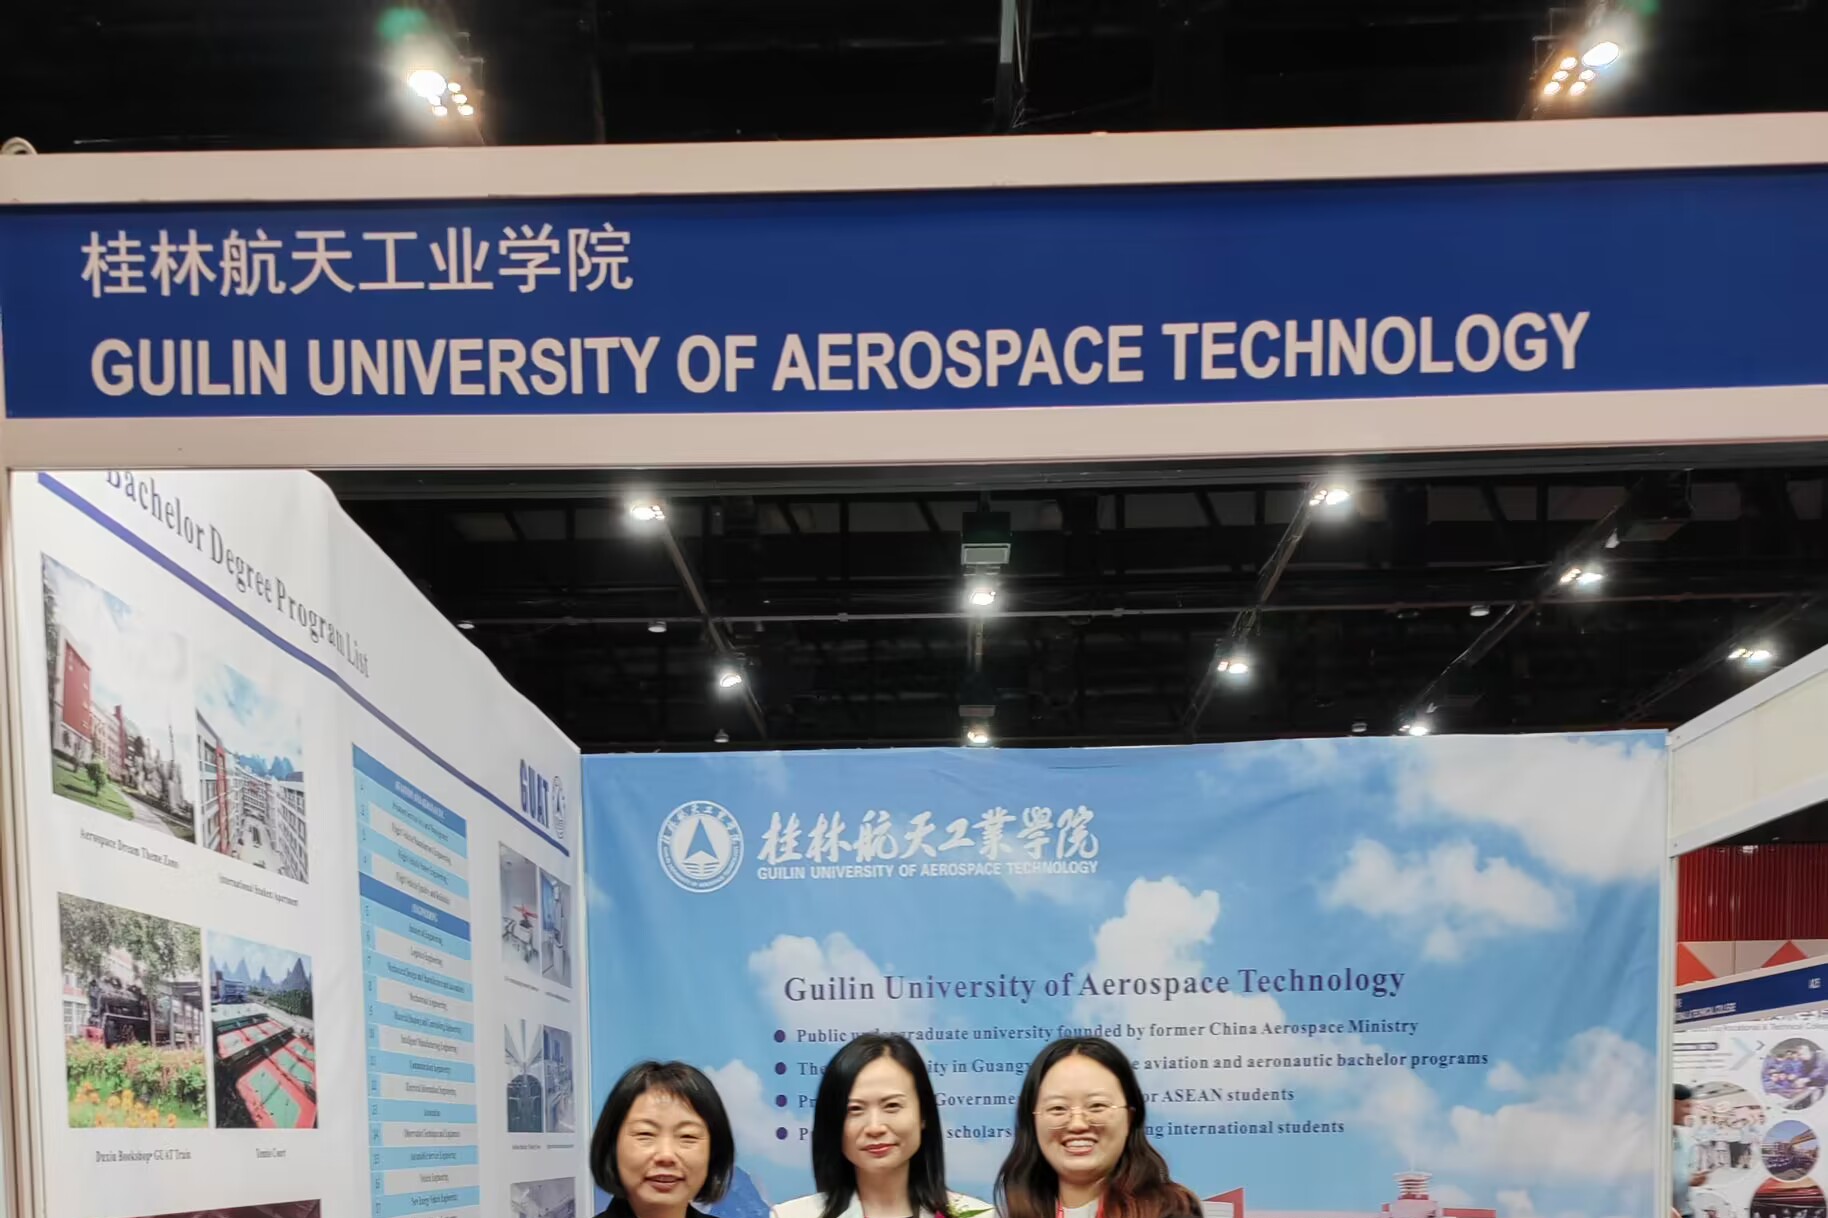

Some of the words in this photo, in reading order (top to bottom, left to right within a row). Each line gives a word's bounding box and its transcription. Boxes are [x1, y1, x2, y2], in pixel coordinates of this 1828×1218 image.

[81, 222, 634, 298] 桂林航天工业学院
[91, 338, 287, 396] GUILIN
[308, 336, 660, 395] UNIVERSITY
[676, 334, 757, 393] OF
[771, 324, 1143, 391] AEROSPACE
[1162, 311, 1590, 380] TECHNOLOGY
[209, 523, 272, 604] Degree
[520, 758, 549, 829] GUAT
[757, 867, 805, 880] GUILIN
[810, 866, 895, 879] UNIVERSITY
[899, 864, 920, 877] OF
[921, 863, 1001, 877] AEROSPACE
[1005, 860, 1098, 875] TECHNOLOGY
[784, 976, 874, 1001] Guilin
[886, 974, 1036, 1003] University
[1045, 972, 1074, 997] of
[1079, 973, 1229, 1000] Aerospace
[1238, 968, 1405, 998] Technology
[797, 1029, 847, 1042] Public
[973, 1026, 1051, 1042] university
[1057, 1024, 1121, 1038] founded
[1126, 1024, 1145, 1040] by
[1149, 1023, 1206, 1037] former
[1209, 1022, 1257, 1036] China
[1261, 1020, 1344, 1037] Aerospace
[1347, 1018, 1419, 1035] Ministry
[952, 1060, 967, 1073] in
[972, 1059, 1032, 1076] Guang
[1144, 1056, 1208, 1069] aviation
[1213, 1055, 1242, 1069] and
[1247, 1054, 1333, 1068] aeronautic
[1337, 1052, 1407, 1067] bachelor
[1410, 1052, 1488, 1069] programs
[935, 1092, 1020, 1106] Governme
[1161, 1088, 1223, 1103] ASEAN
[1227, 1087, 1294, 1101] students
[1168, 1121, 1273, 1135] international
[1277, 1119, 1344, 1134] students
